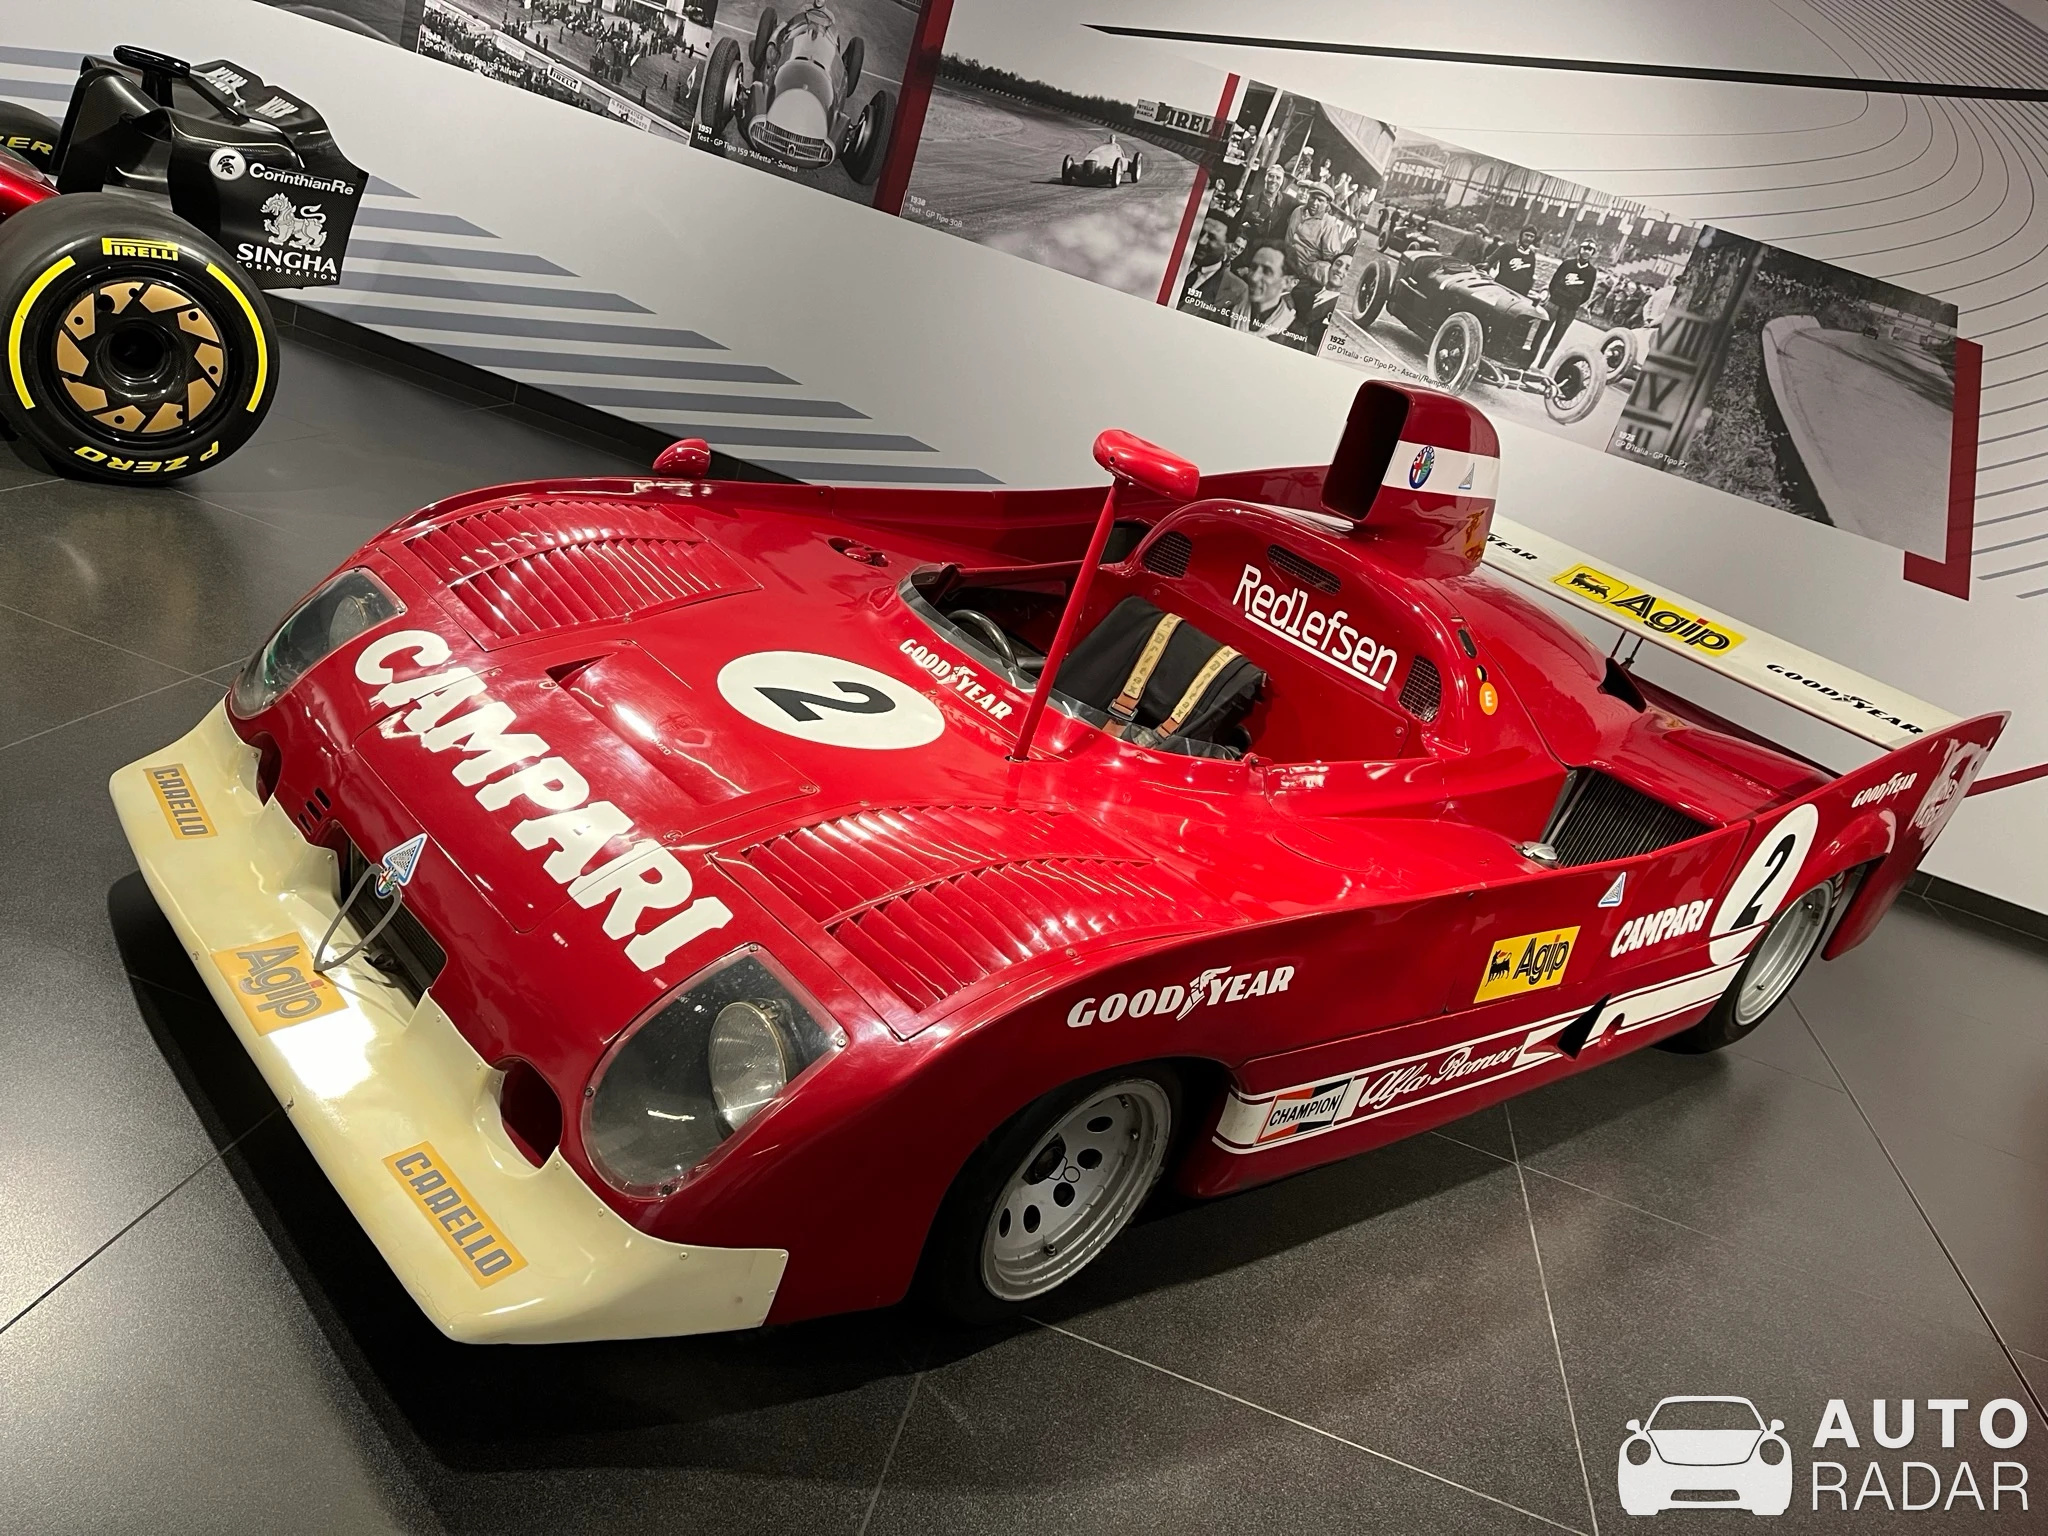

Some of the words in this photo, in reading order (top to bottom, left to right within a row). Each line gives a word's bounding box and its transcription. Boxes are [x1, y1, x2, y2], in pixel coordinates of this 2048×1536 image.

[698, 124, 712, 134] 1951
[697, 133, 709, 143] Test
[723, 142, 736, 152] Tipo
[737, 148, 748, 157] 159
[778, 160, 798, 173] Sanesi
[249, 163, 354, 195] CorinthianRe
[909, 203, 921, 214] Test
[925, 210, 936, 218] GP
[936, 213, 949, 223] Tipo
[910, 195, 926, 206] 1938
[101, 237, 180, 261] PIRELLI
[237, 243, 337, 275] SINGHA
[1184, 297, 1195, 305] GP
[1187, 288, 1203, 298] 1931
[1329, 335, 1346, 346] 1925
[1337, 347, 1358, 360] D'Italia
[1363, 355, 1373, 364] GP
[1374, 359, 1388, 370] Tipo
[1388, 364, 1397, 372] P2
[200, 440, 219, 462] P
[1615, 439, 1625, 448] GP
[1652, 451, 1664, 460] GP
[1663, 453, 1678, 466] Tipo
[1618, 431, 1636, 442] 1925
[74, 446, 190, 473] ZERO
[1232, 563, 1398, 686] Redlefsen
[1609, 593, 1730, 650] Agip
[753, 681, 896, 722] 2
[1485, 691, 1493, 707] E
[153, 768, 209, 837] CARELLO
[355, 630, 734, 973] CAMPARI
[1729, 834, 1796, 931] 2
[1610, 898, 1714, 958] CAMPARI
[1512, 934, 1569, 985] Agip
[236, 945, 324, 1019] Agip
[1358, 1065, 1432, 1110] Alfa
[1430, 1045, 1523, 1085] Romeo
[1269, 1094, 1341, 1126] CHAMPION
[395, 1152, 513, 1277] CARELLO
